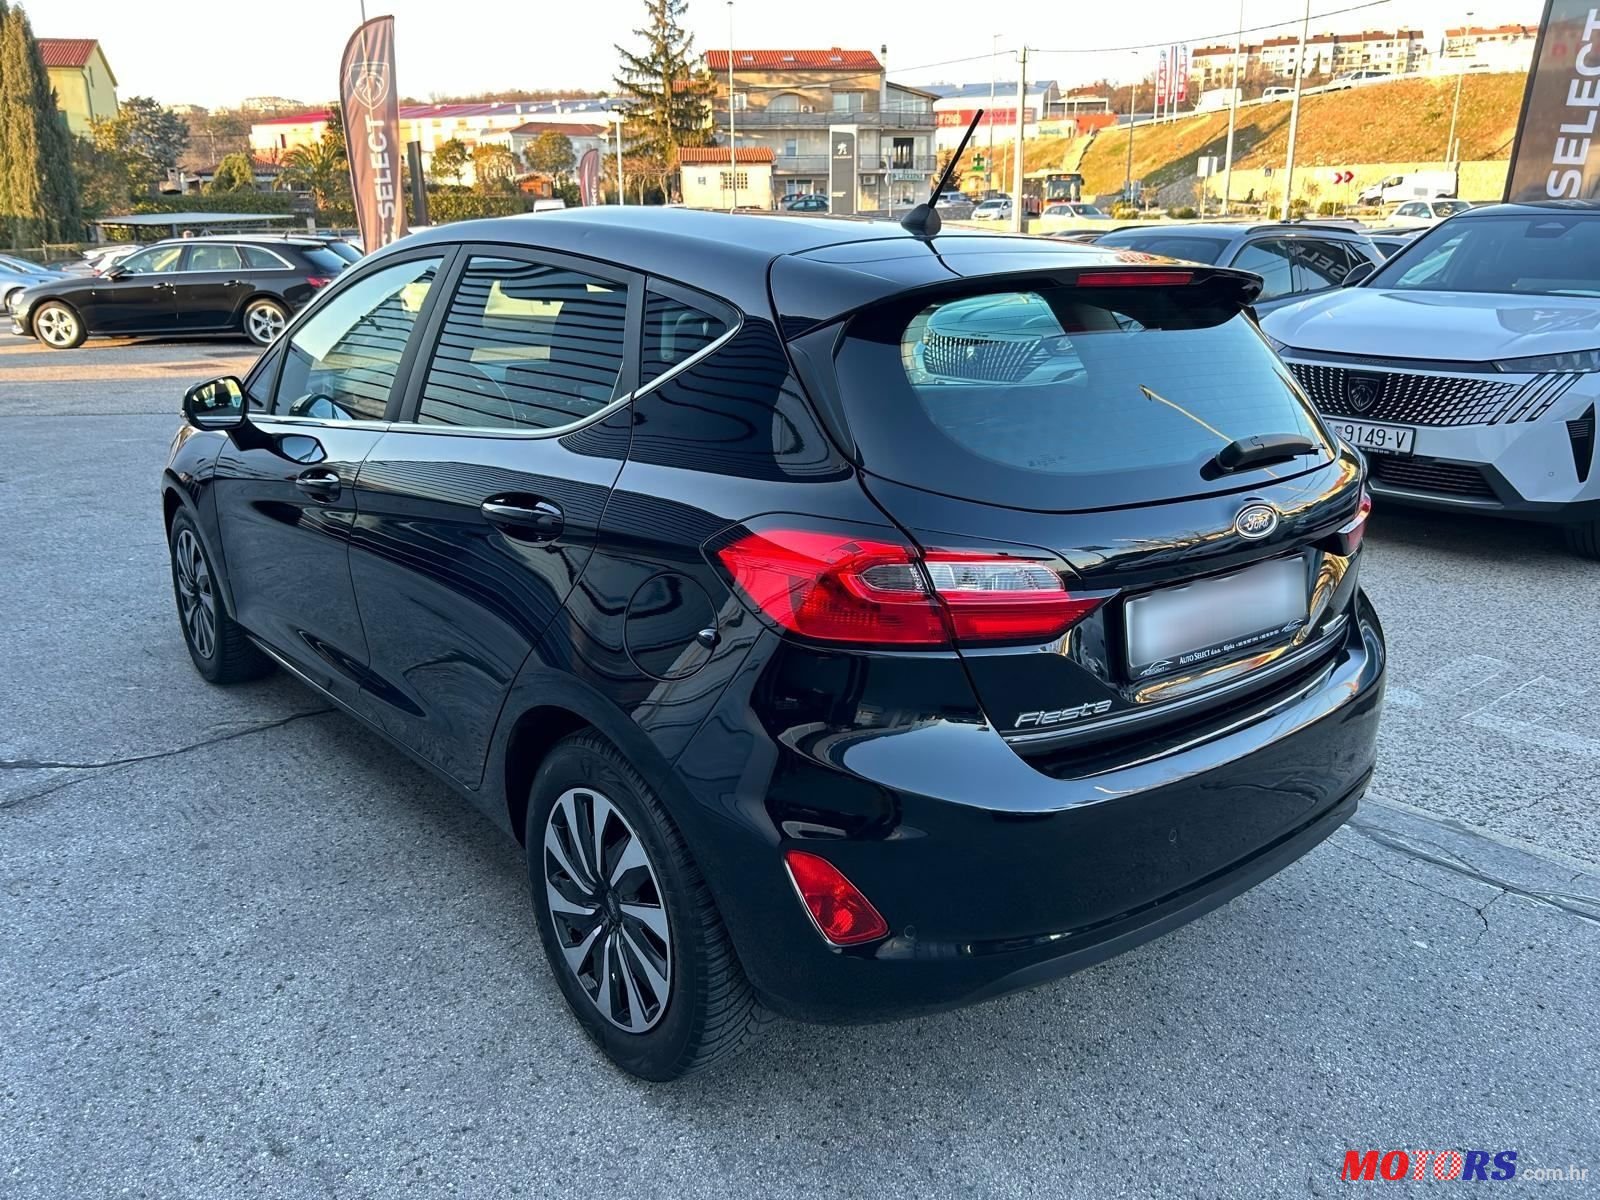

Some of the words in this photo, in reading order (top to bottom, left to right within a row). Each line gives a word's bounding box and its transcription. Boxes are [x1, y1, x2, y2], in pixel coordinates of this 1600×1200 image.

[1546, 9, 1600, 198] SELECT
[364, 115, 395, 219] SELECT
[1344, 424, 1407, 449] 9149-V
[1243, 511, 1272, 531] Ford
[1179, 654, 1195, 665] AUTO
[1194, 649, 1211, 661] SELECT
[1014, 699, 1113, 728] Fiesta
